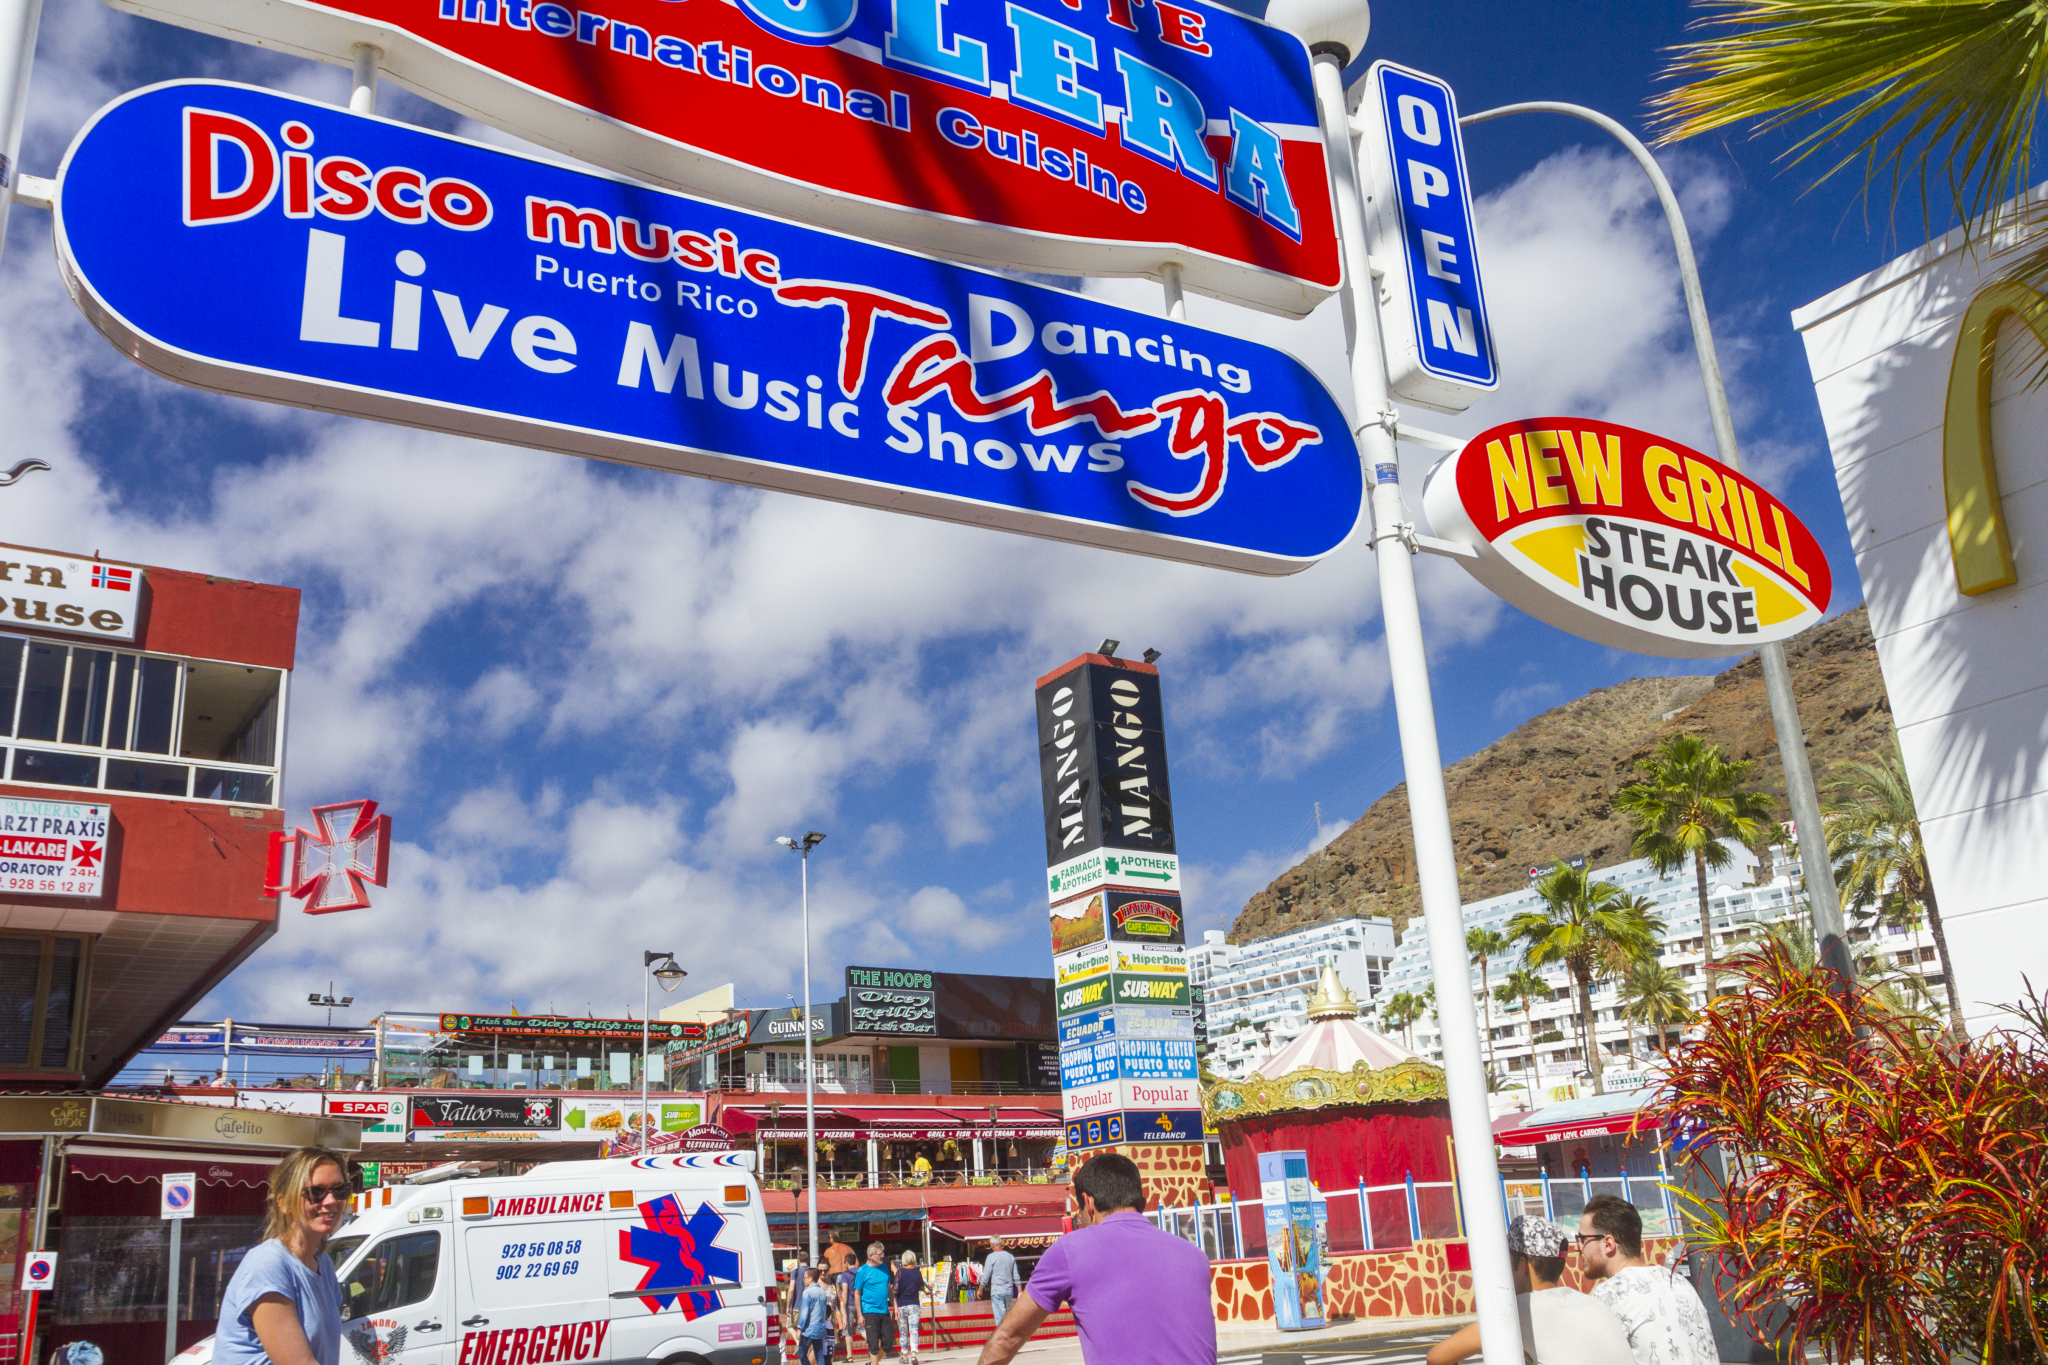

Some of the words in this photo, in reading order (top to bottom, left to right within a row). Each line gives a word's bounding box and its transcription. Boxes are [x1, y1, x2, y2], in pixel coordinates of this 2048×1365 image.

[936, 107, 1147, 214] Cuisine
[182, 106, 493, 231] Disco
[524, 195, 781, 288] music
[1397, 94, 1478, 357] OPEN
[535, 254, 662, 302] Puerto
[676, 280, 758, 319] Rico
[300, 228, 577, 374] Live
[617, 320, 859, 438] Music
[885, 405, 1125, 474] Shows
[968, 293, 1252, 394] Dancing
[773, 278, 1322, 517] Tango
[1486, 430, 1622, 522] NEW
[1643, 446, 1811, 592] GRILL
[1586, 517, 1739, 587] STEAK
[1580, 553, 1758, 634] HOUSE
[1051, 686, 1085, 850] MANGO
[1110, 679, 1152, 840] MANGO
[5, 801, 80, 818] PALMERAS
[0, 815, 38, 832] RZT
[43, 818, 105, 837] PRAXIS
[1060, 856, 1101, 879] FARMACIA
[1121, 855, 1176, 870] APOTHEKE
[9, 878, 34, 890] 928
[39, 880, 55, 891] 56
[61, 882, 73, 892] 12
[78, 882, 94, 893] 87
[1062, 868, 1103, 892] APOTHEKE
[1122, 903, 1171, 920] HARLEY'S
[1127, 923, 1142, 931] CAFE
[1145, 924, 1168, 933] DANCING
[1068, 955, 1109, 974] HiperDino
[1132, 953, 1187, 965] HiperDino
[1092, 965, 1109, 974] Express
[851, 969, 881, 986] THE
[884, 971, 932, 989] HOOPS
[1060, 980, 1108, 1011] SUBWAY
[1119, 980, 1184, 999] SUBWAY
[858, 991, 930, 1006] Dicey
[853, 1006, 935, 1021] Reilly's
[475, 1017, 500, 1026] Irish
[502, 1018, 523, 1026] Bar
[527, 1018, 569, 1029] Dicey
[573, 1019, 621, 1030] Reilly's
[768, 1019, 825, 1034] GUINNSS
[855, 1020, 898, 1031] Irish
[900, 1022, 933, 1033] Bar
[1062, 1018, 1080, 1028] VIAJES
[1066, 1021, 1104, 1039] ECUADOR
[1128, 1019, 1178, 1028] ECUADOR
[1061, 1047, 1093, 1068] SHOPPING
[1094, 1041, 1117, 1060] CENTER
[1120, 1041, 1161, 1057] SHOPPING
[1164, 1041, 1194, 1057] CENTER
[1065, 1064, 1093, 1080] PUERTO
[1096, 1059, 1115, 1073] RICO
[1125, 1059, 1163, 1070] PUERTO
[1167, 1059, 1191, 1070] RICO
[1071, 1076, 1098, 1086] FASE
[1071, 1090, 1113, 1112] Popular
[1132, 1085, 1189, 1105] Popular
[51, 1107, 87, 1118] CARTE
[99, 1104, 144, 1125] Tapas
[343, 1103, 388, 1113] SPAR
[437, 1097, 493, 1121] Tattoo
[493, 1109, 520, 1122] Piercing
[664, 1111, 694, 1119] SUBWAY
[54, 1117, 83, 1127] D'OR
[215, 1112, 263, 1138] Cafelito
[688, 1126, 729, 1139] Mau-Mau
[1143, 1132, 1186, 1140] TELEBANCO
[1545, 1132, 1561, 1142] BABY
[1563, 1130, 1578, 1140] LOVE
[1580, 1127, 1609, 1138] CARROSEL
[686, 1141, 731, 1149] RESTAURANTE
[208, 1166, 233, 1178] Cafelito
[382, 1166, 394, 1176] Taj
[493, 1194, 605, 1217] AMBULANCE
[979, 1205, 1028, 1218] Lal's
[1267, 1208, 1284, 1217] Lago
[1266, 1217, 1287, 1226] Taurito
[1291, 1213, 1311, 1221] Taurito
[501, 1243, 526, 1259] 928
[528, 1242, 545, 1257] 56
[546, 1241, 563, 1256] 08
[565, 1239, 582, 1254] 58
[1017, 1237, 1045, 1245] PRICE
[496, 1264, 521, 1280] 902
[525, 1263, 542, 1278] 22
[543, 1261, 561, 1277] 69
[562, 1260, 579, 1275] 69
[360, 1319, 398, 1331] ZANDRO
[458, 1320, 610, 1365] EMERGENCY
